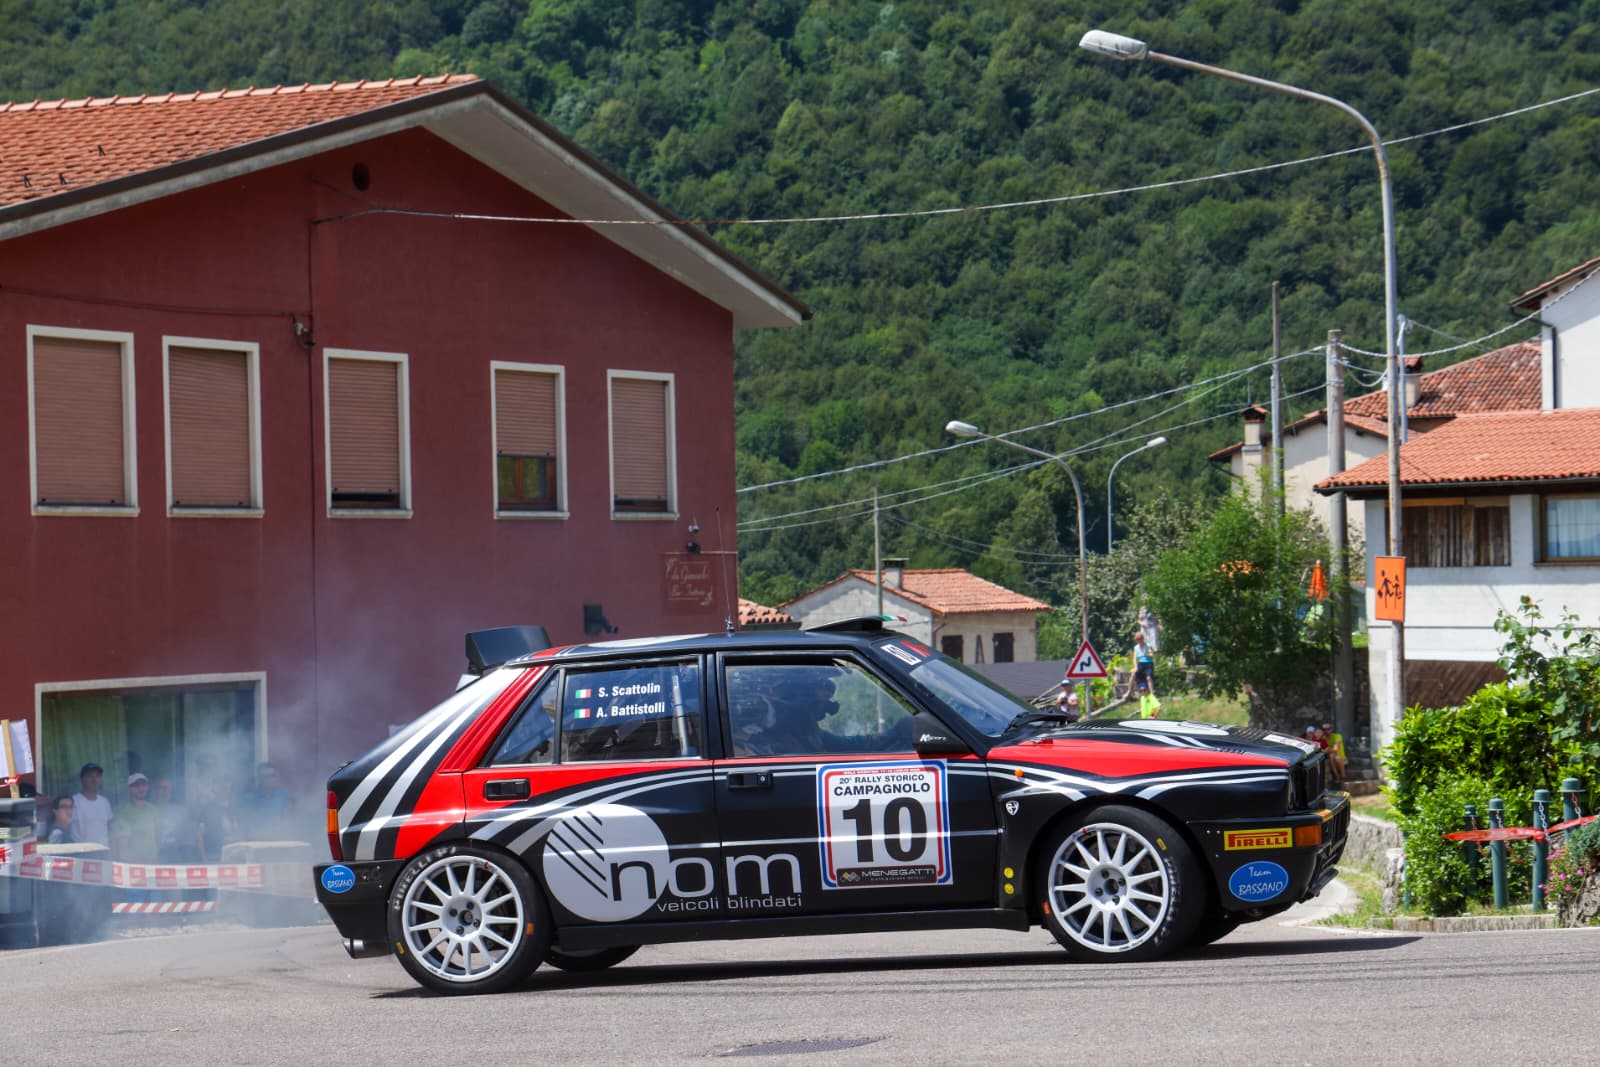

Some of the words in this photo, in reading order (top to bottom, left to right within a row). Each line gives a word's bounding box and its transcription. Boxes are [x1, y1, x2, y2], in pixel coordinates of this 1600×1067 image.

[598, 687, 609, 698] S.
[611, 682, 661, 697] Scattolin
[596, 706, 608, 718] A.
[611, 702, 665, 717] Battistolli
[855, 775, 882, 784] RALLY
[885, 774, 925, 783] STORICO
[834, 782, 931, 797] CAMPAGNOLO
[842, 796, 928, 863] 10
[1228, 831, 1289, 848] PIRELLI
[610, 853, 802, 902] nom
[861, 868, 935, 877] MENEGATTI
[1248, 866, 1272, 878] Team
[1238, 881, 1284, 896] BASSANO
[656, 897, 720, 913] veicoli
[727, 894, 802, 910] blindati
